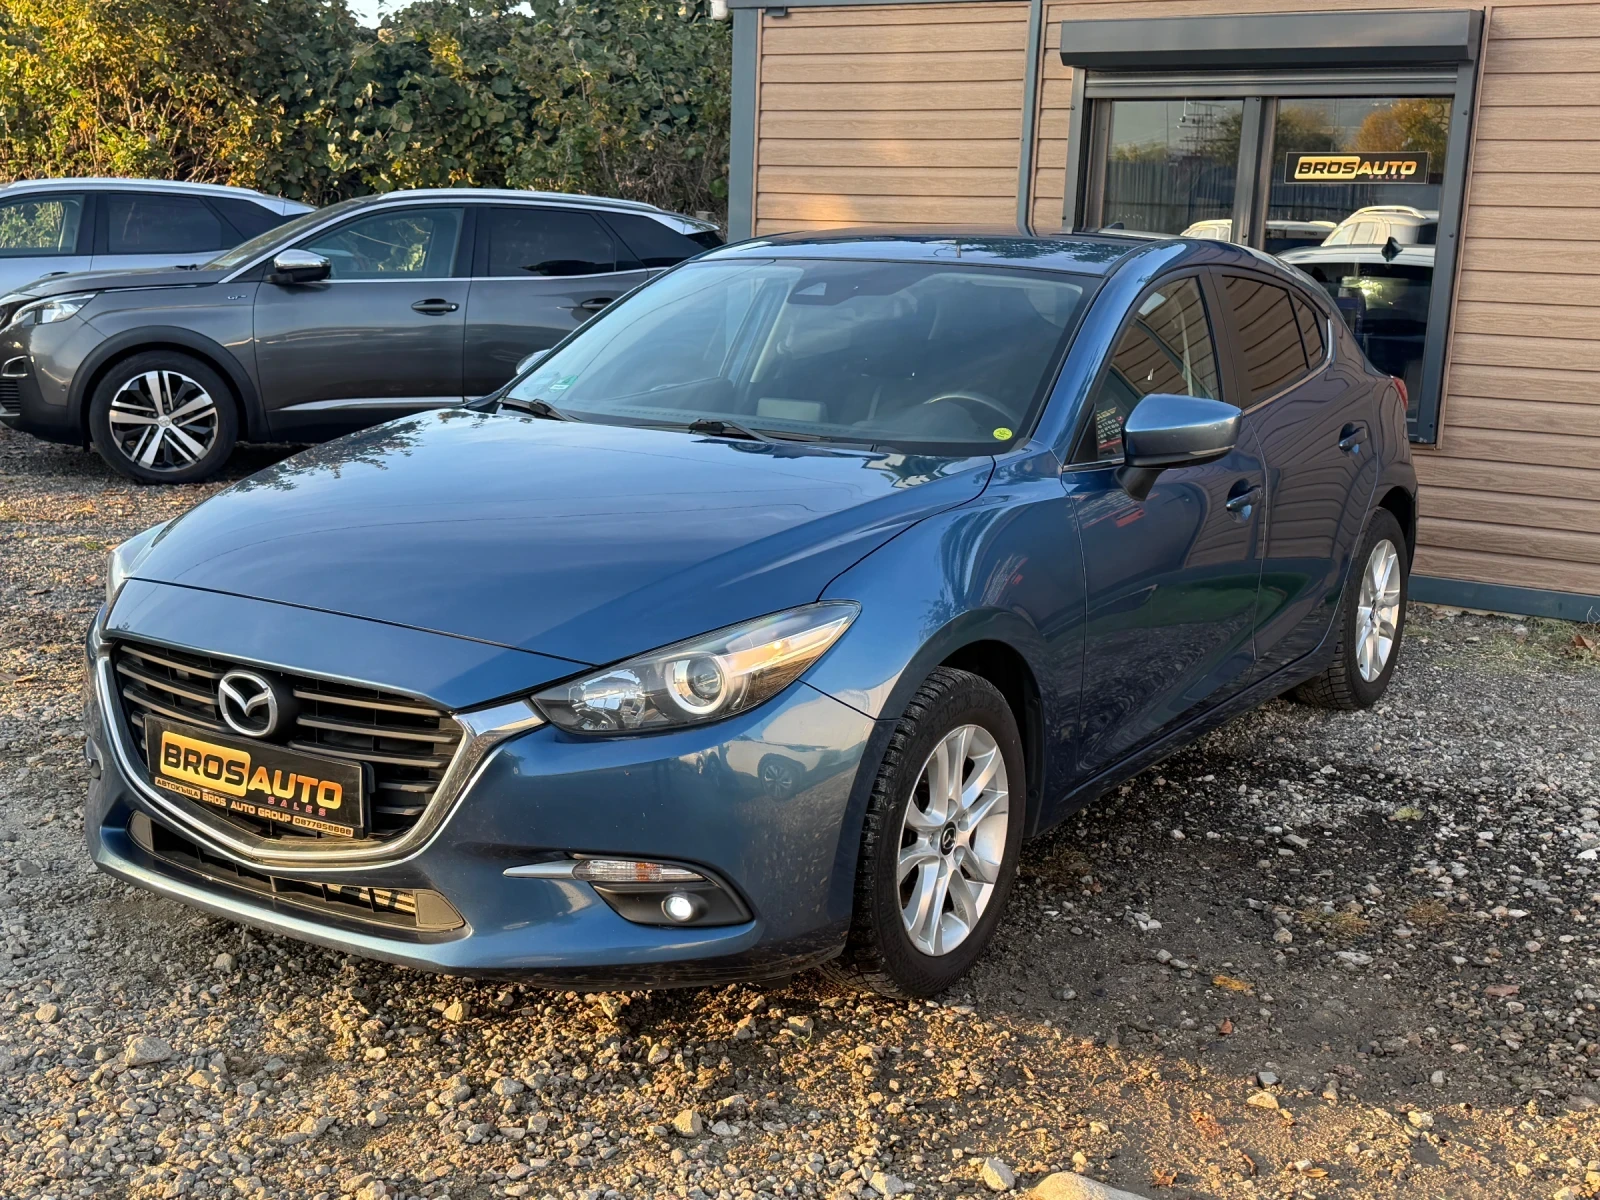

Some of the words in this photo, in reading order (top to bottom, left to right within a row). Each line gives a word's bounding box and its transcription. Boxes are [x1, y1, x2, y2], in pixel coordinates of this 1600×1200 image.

[202, 792, 227, 807] BROS
[230, 800, 256, 815] AUTO
[257, 807, 292, 822] GROUP
[268, 796, 327, 817] SALES
